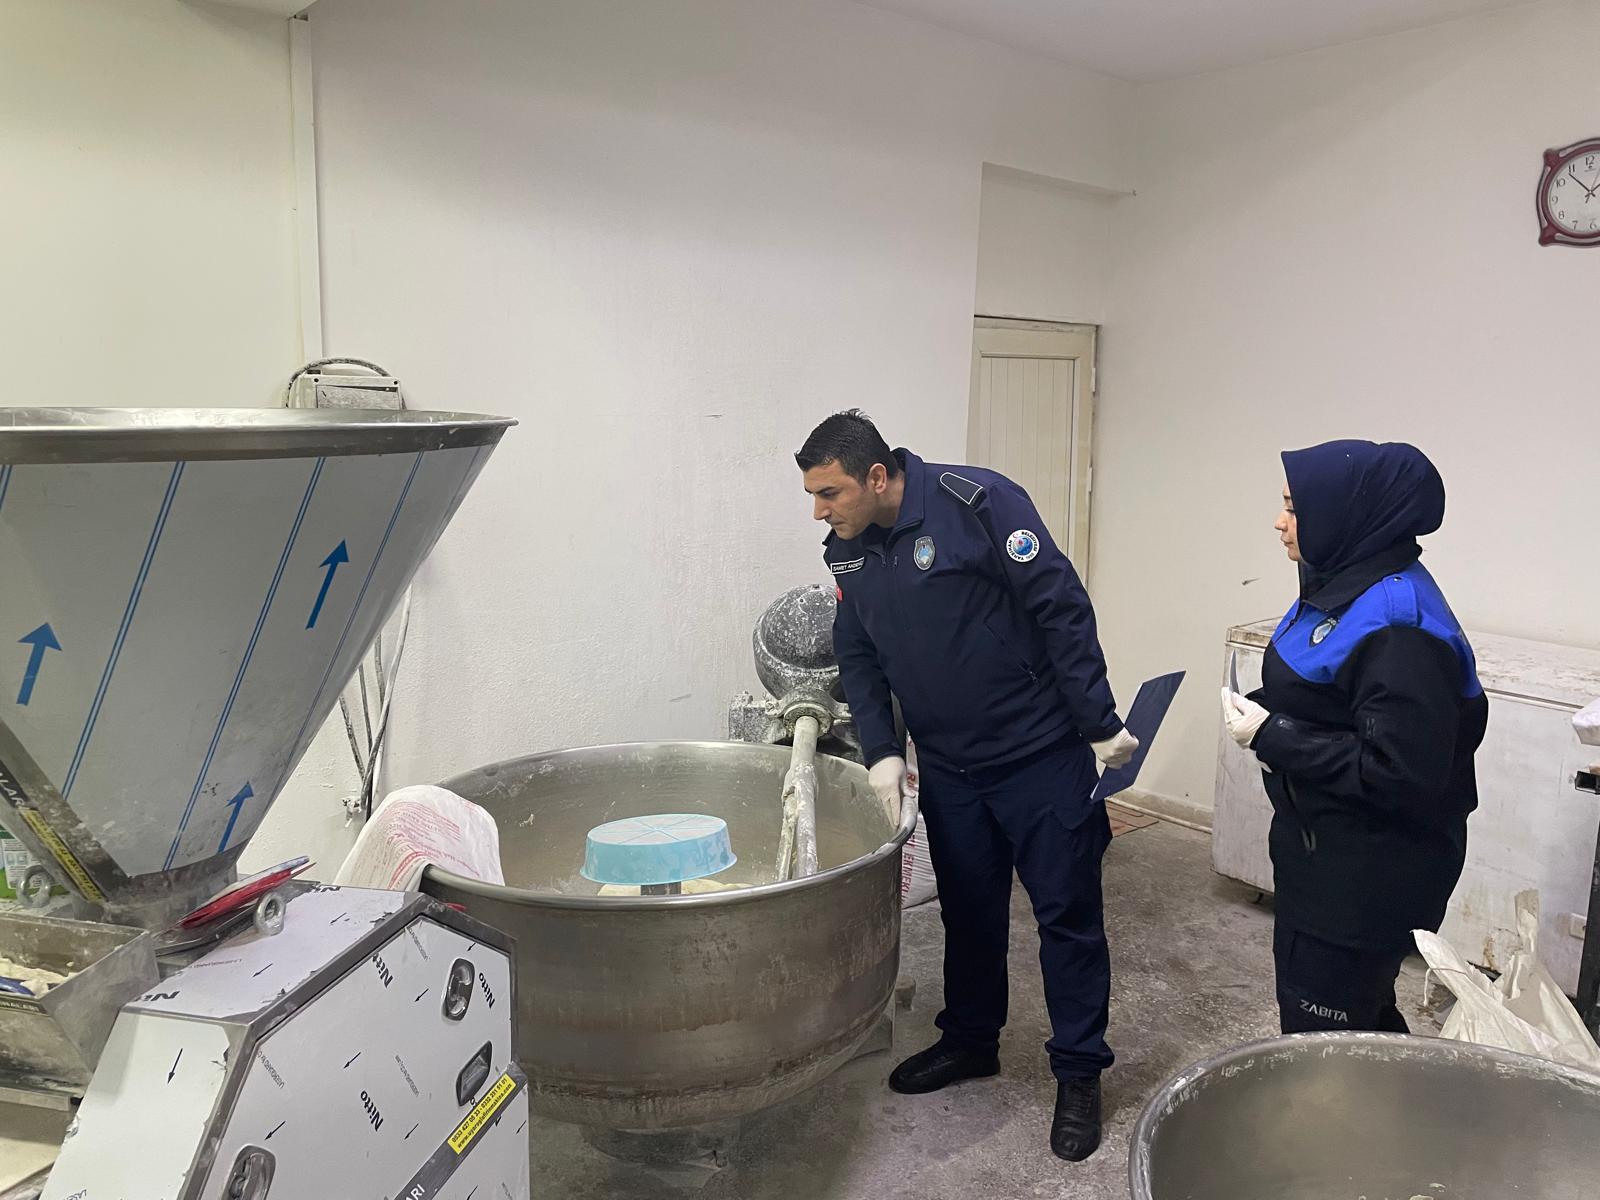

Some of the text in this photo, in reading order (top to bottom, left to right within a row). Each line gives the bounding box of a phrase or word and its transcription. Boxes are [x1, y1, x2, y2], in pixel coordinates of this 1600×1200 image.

[1585, 155, 1595, 166] 12
[1568, 163, 1576, 174] 11
[1556, 178, 1566, 188] 10
[1551, 196, 1558, 206] 9
[1559, 210, 1565, 220] 8
[1572, 220, 1578, 230] 7
[1589, 220, 1597, 230] 6
[478, 972, 496, 1009] Nitto
[1299, 999, 1348, 1023] ZABITA
[360, 1090, 384, 1132] Nitto
